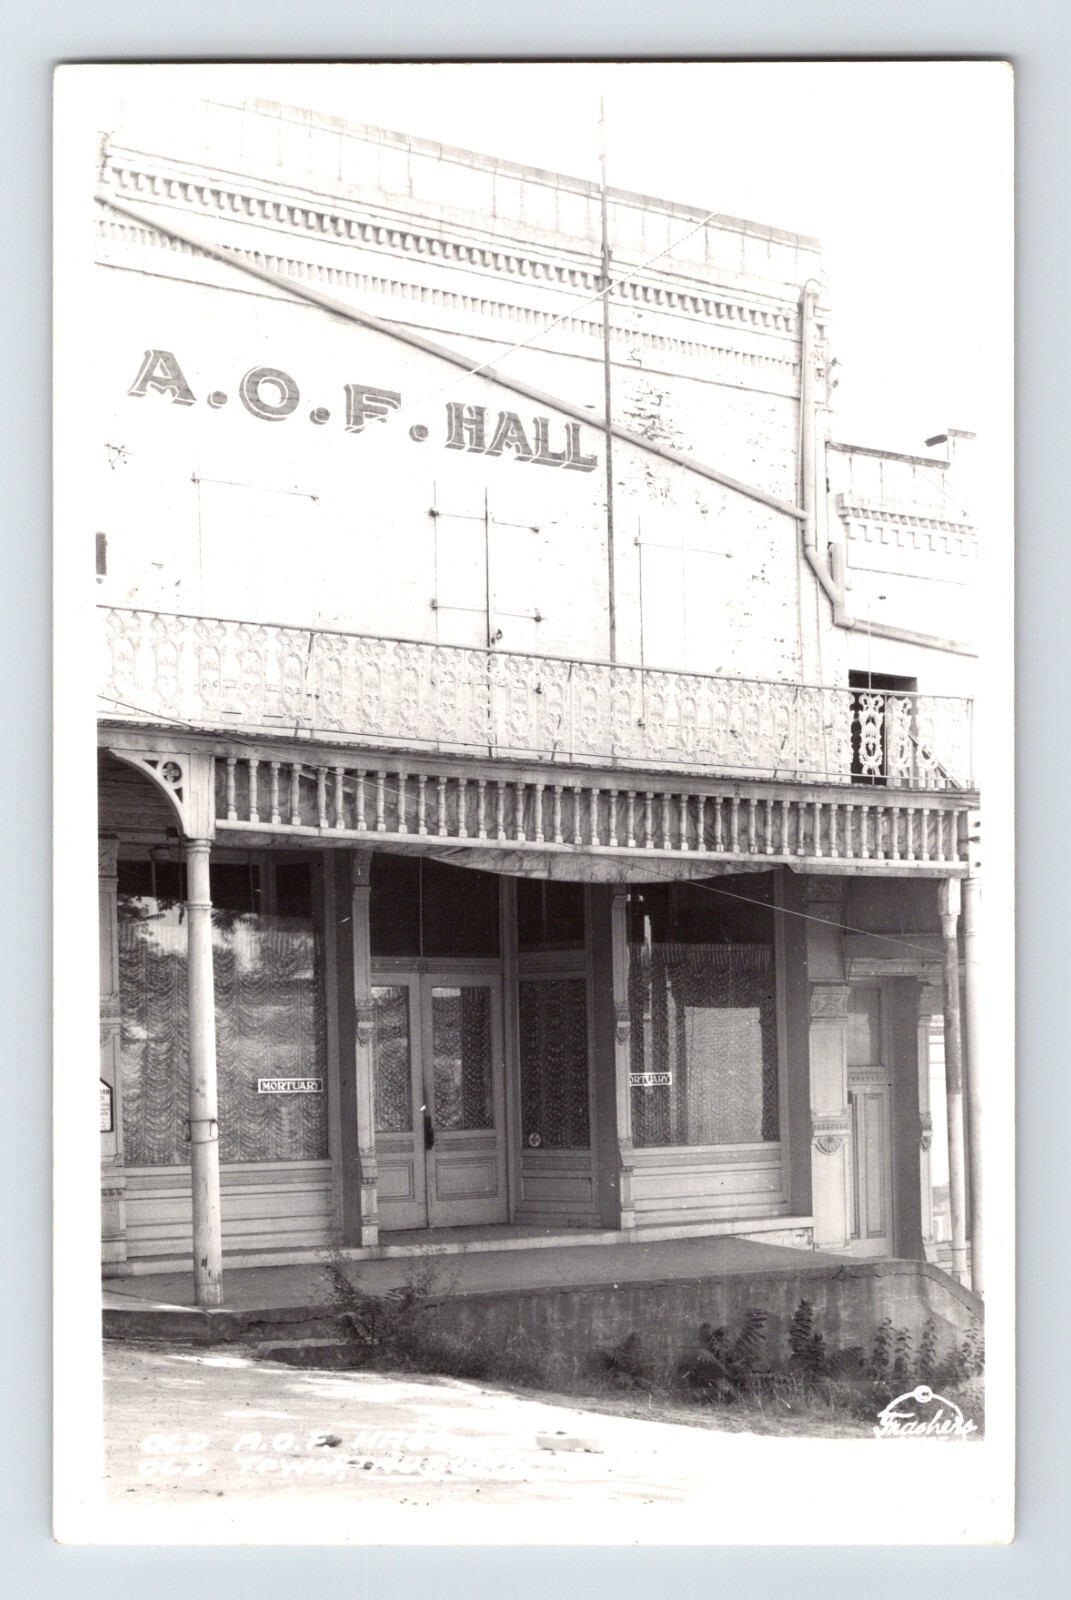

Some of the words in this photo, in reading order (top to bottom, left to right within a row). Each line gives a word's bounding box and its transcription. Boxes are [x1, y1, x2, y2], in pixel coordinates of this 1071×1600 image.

[444, 401, 598, 473] HALL
[629, 1075, 669, 1083] ORTUARY
[262, 1081, 319, 1091] MORTUARY
